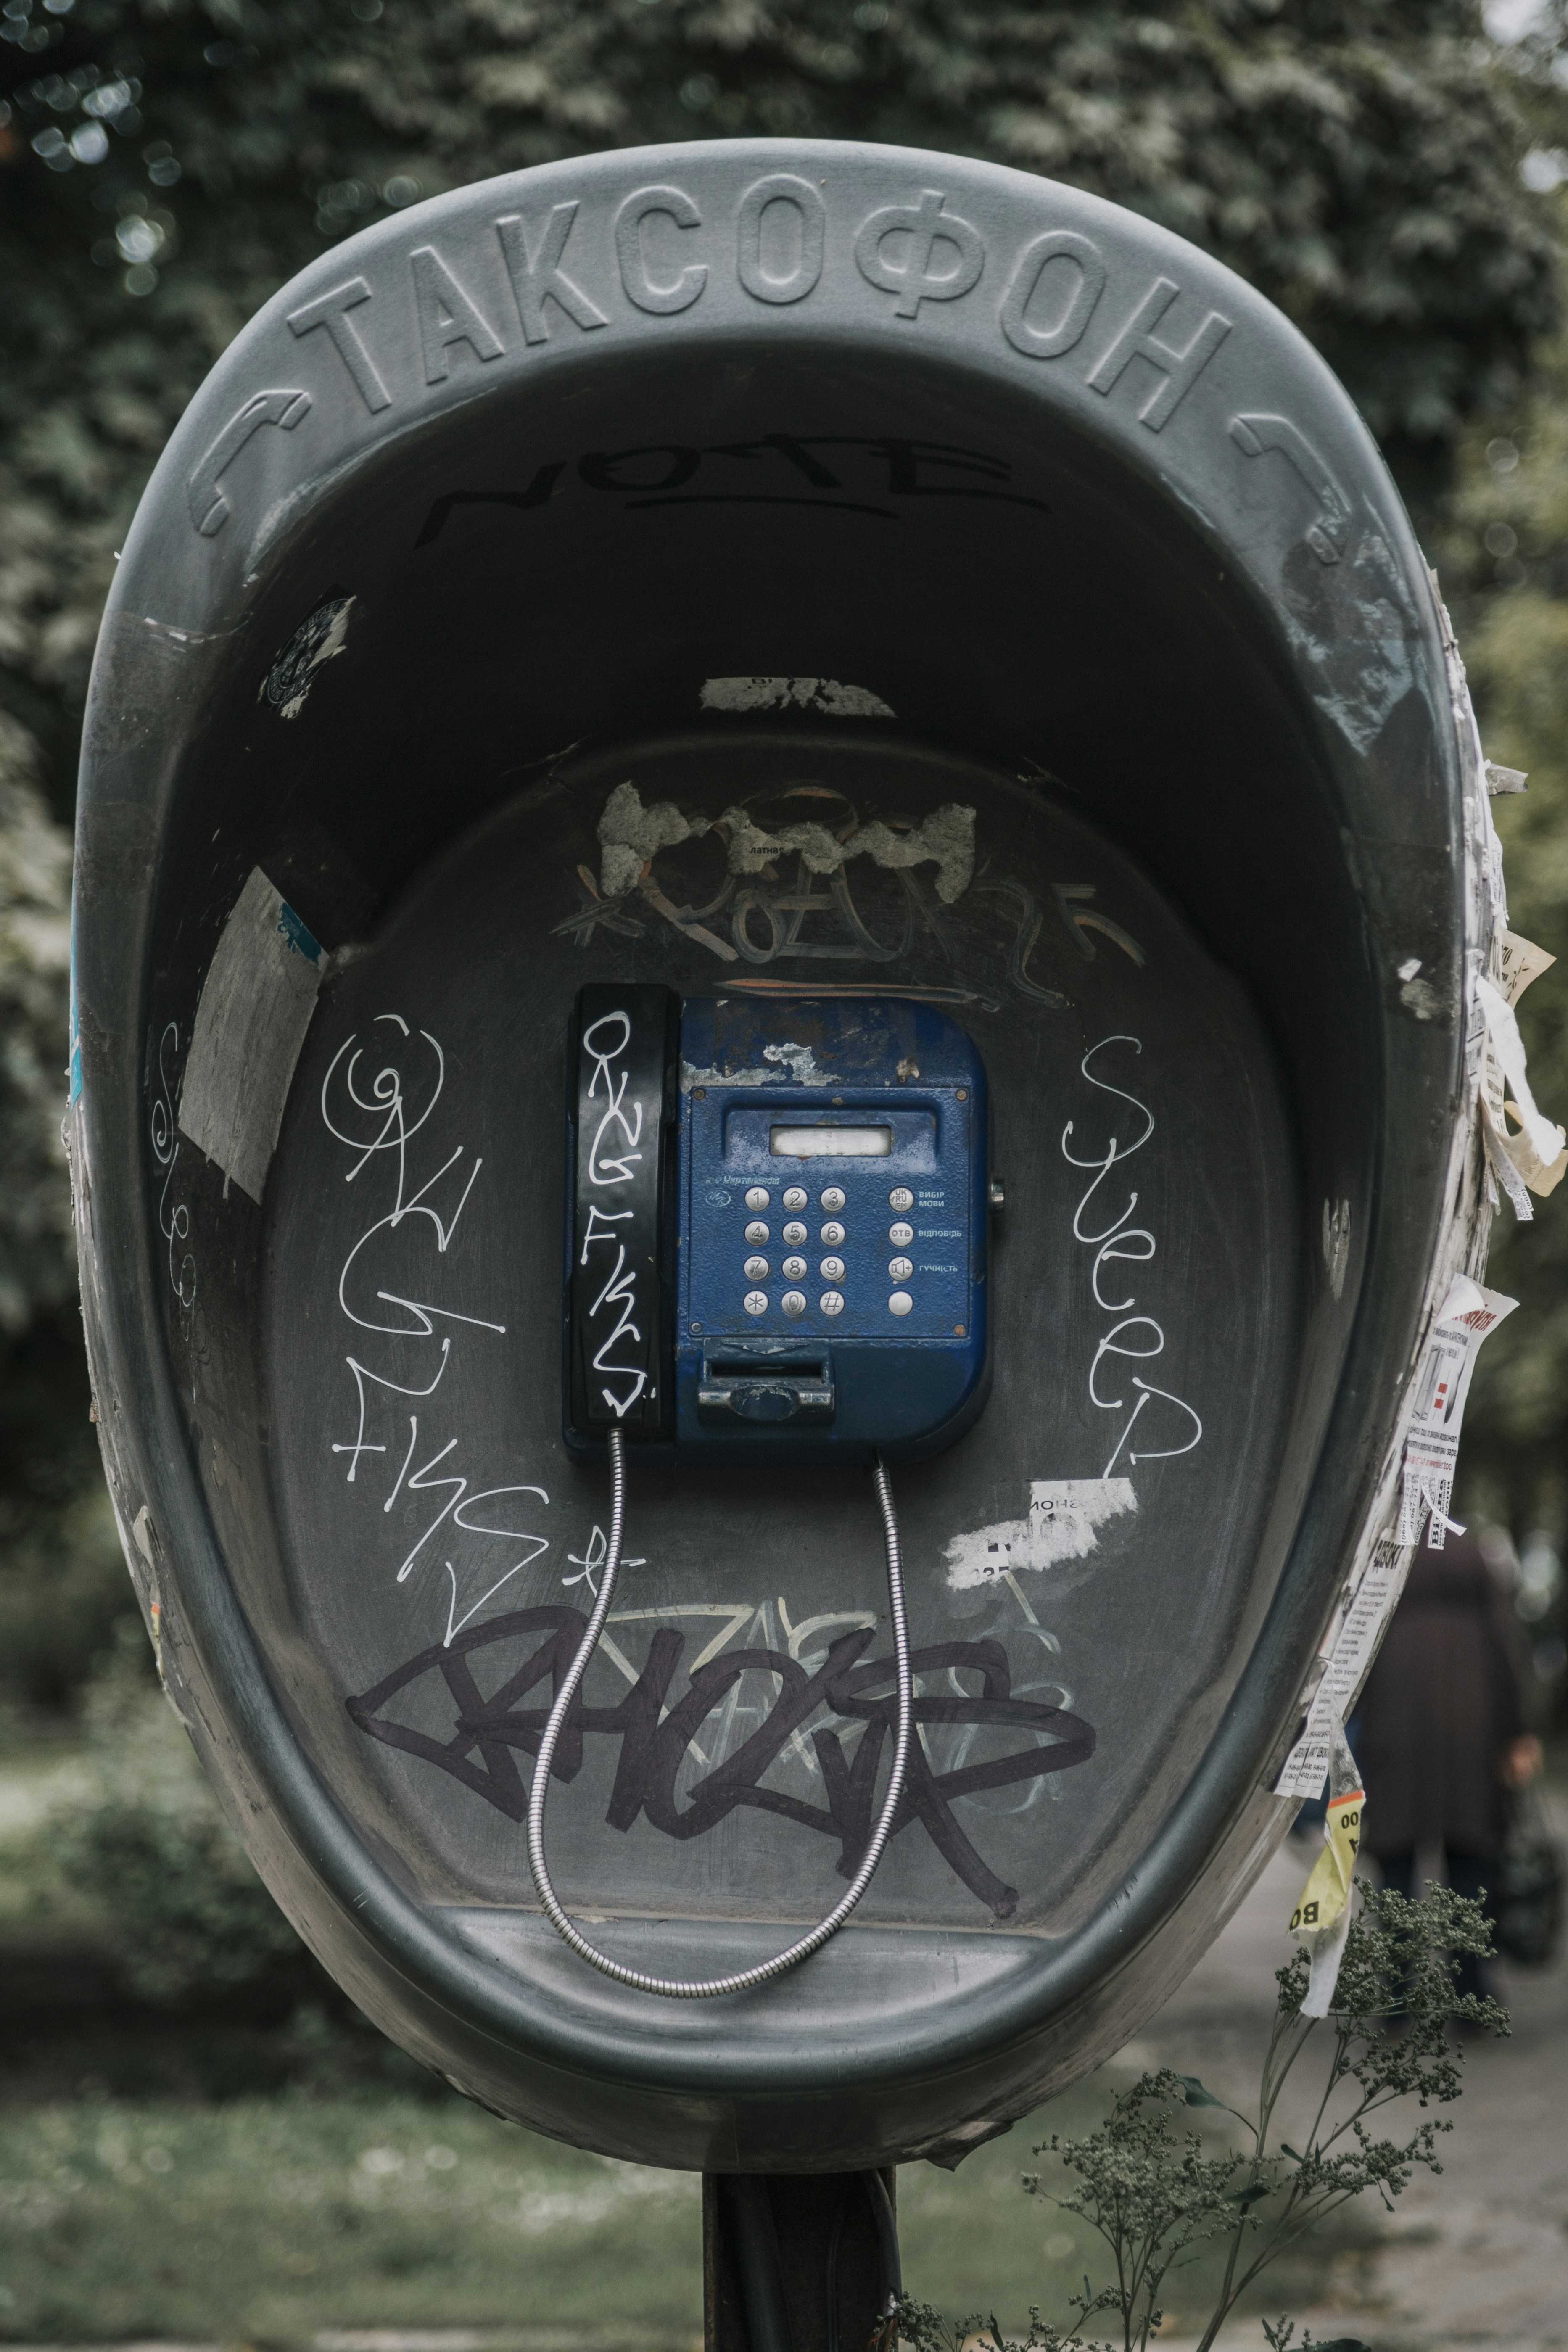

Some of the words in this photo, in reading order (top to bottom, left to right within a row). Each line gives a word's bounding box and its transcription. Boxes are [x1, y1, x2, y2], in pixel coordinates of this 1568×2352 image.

[287, 174, 1231, 433] ТАКСОФОН
[753, 1191, 760, 1206] 1
[790, 1191, 800, 1206] 2
[828, 1191, 838, 1207] 3
[751, 1225, 763, 1241] 4
[790, 1225, 801, 1242] 5
[827, 1225, 838, 1241] 6
[751, 1259, 762, 1276] 7
[789, 1259, 801, 1275] 8
[826, 1260, 838, 1277] 9
[788, 1294, 799, 1310] 0
